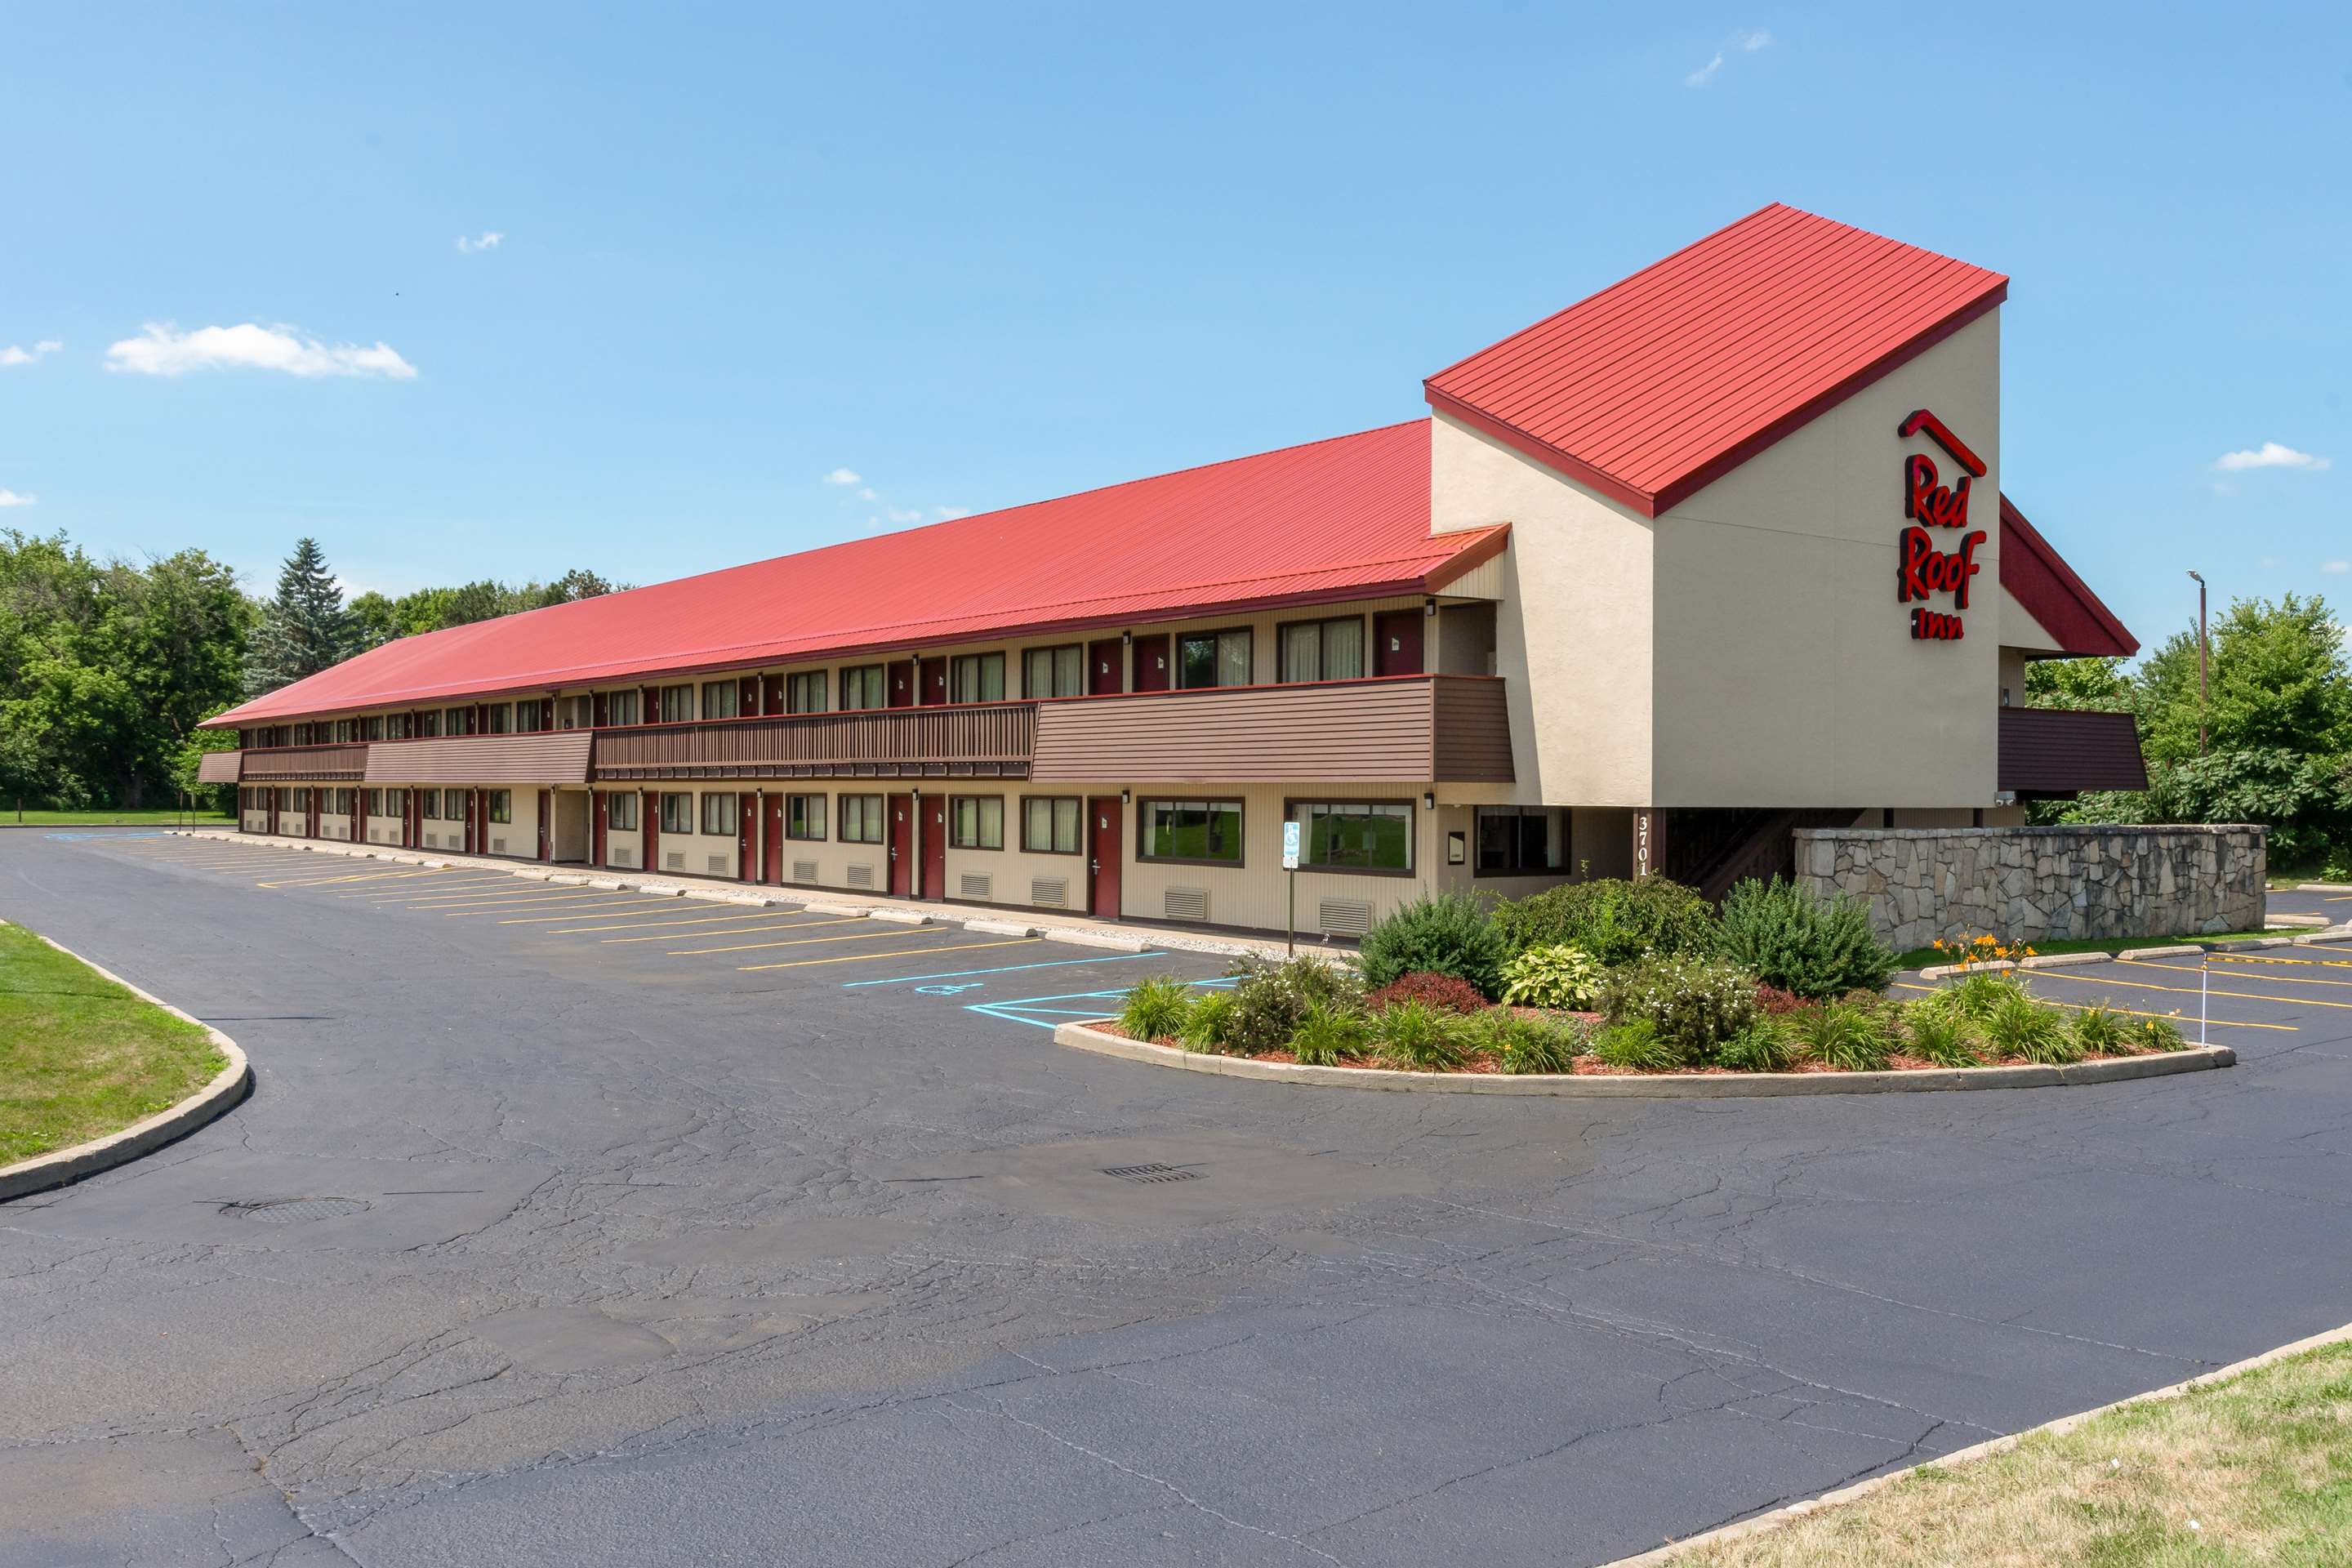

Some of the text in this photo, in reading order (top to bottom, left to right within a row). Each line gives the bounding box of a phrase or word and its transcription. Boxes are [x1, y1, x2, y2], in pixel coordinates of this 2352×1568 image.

[1904, 453, 1971, 528] Red
[1897, 526, 1987, 609] Roof
[1638, 817, 1648, 876] 3701
